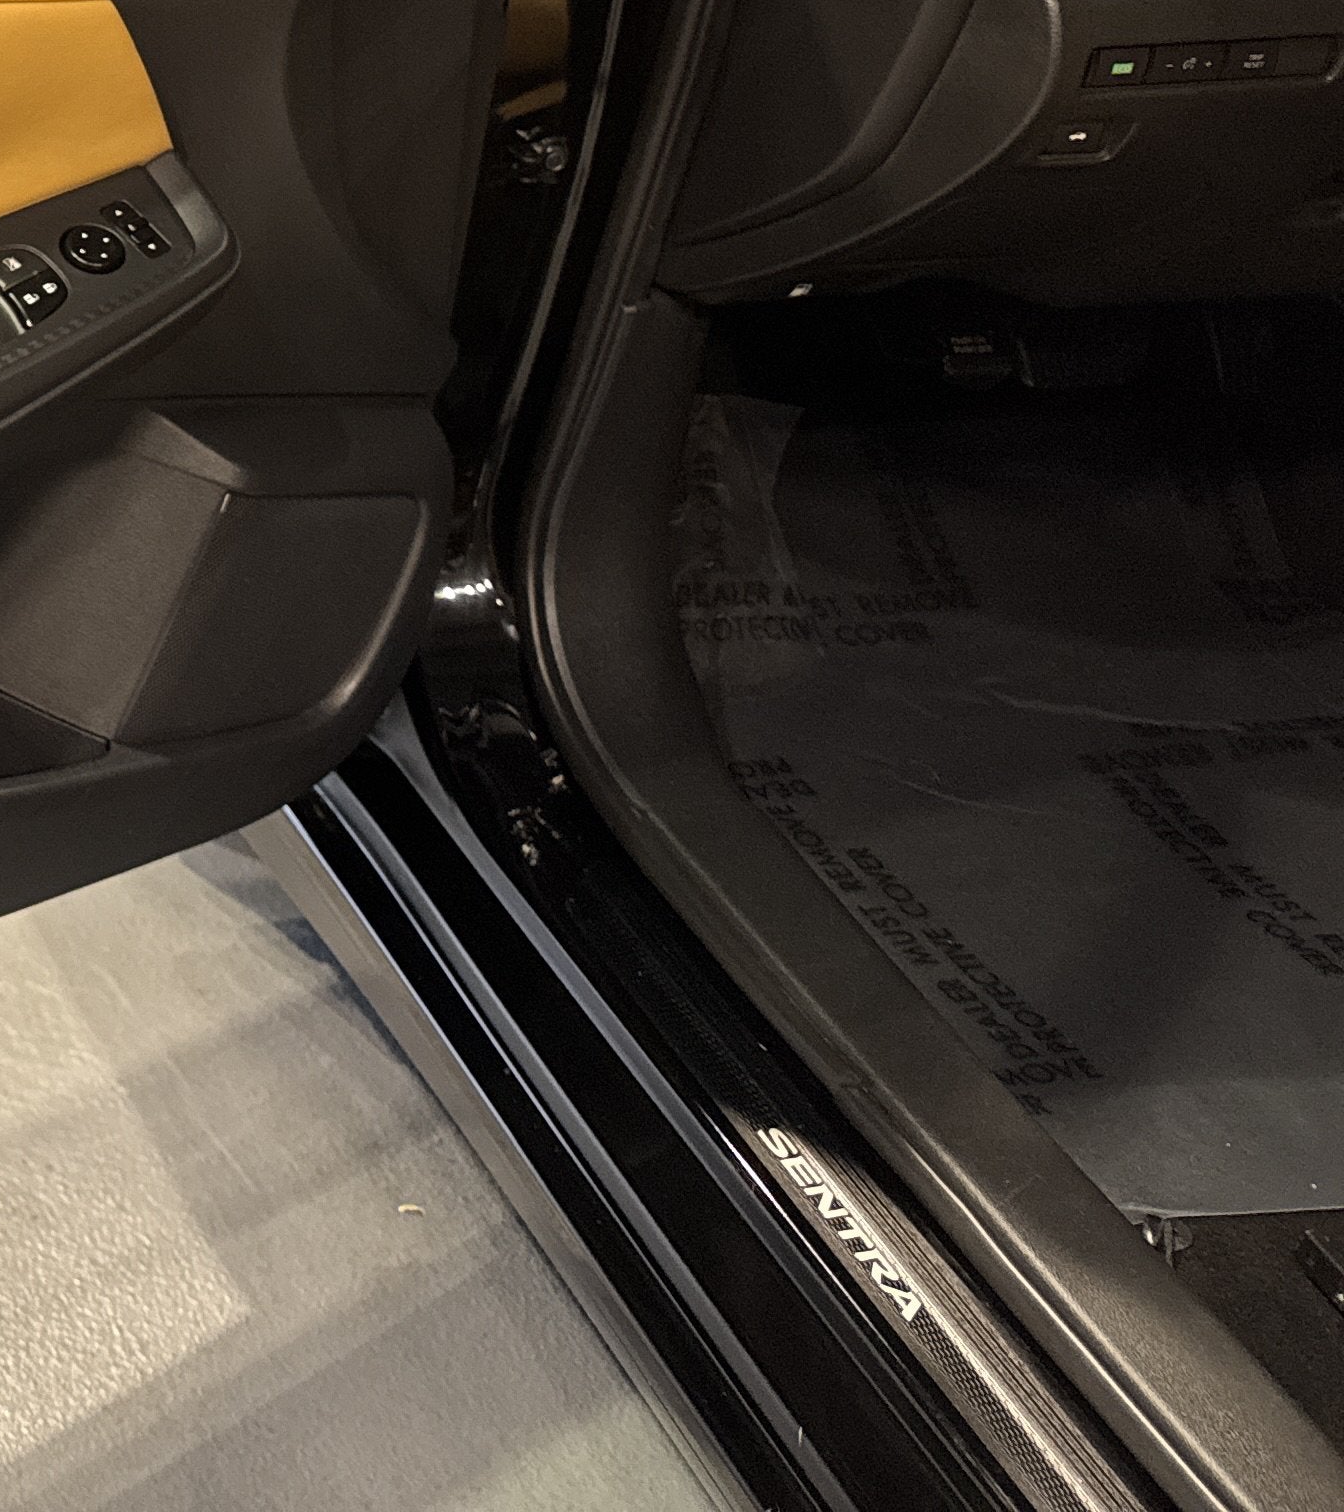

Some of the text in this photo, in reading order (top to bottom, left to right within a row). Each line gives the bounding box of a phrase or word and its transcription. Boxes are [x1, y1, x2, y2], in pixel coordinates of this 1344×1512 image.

[765, 804, 1034, 1064] DEALER MUST REMOVE
[846, 846, 1080, 1054] PROTECTIVE COVER
[1227, 863, 1317, 921] MUST
[1246, 909, 1344, 975] COVER
[756, 1127, 923, 1322] SENTRA
